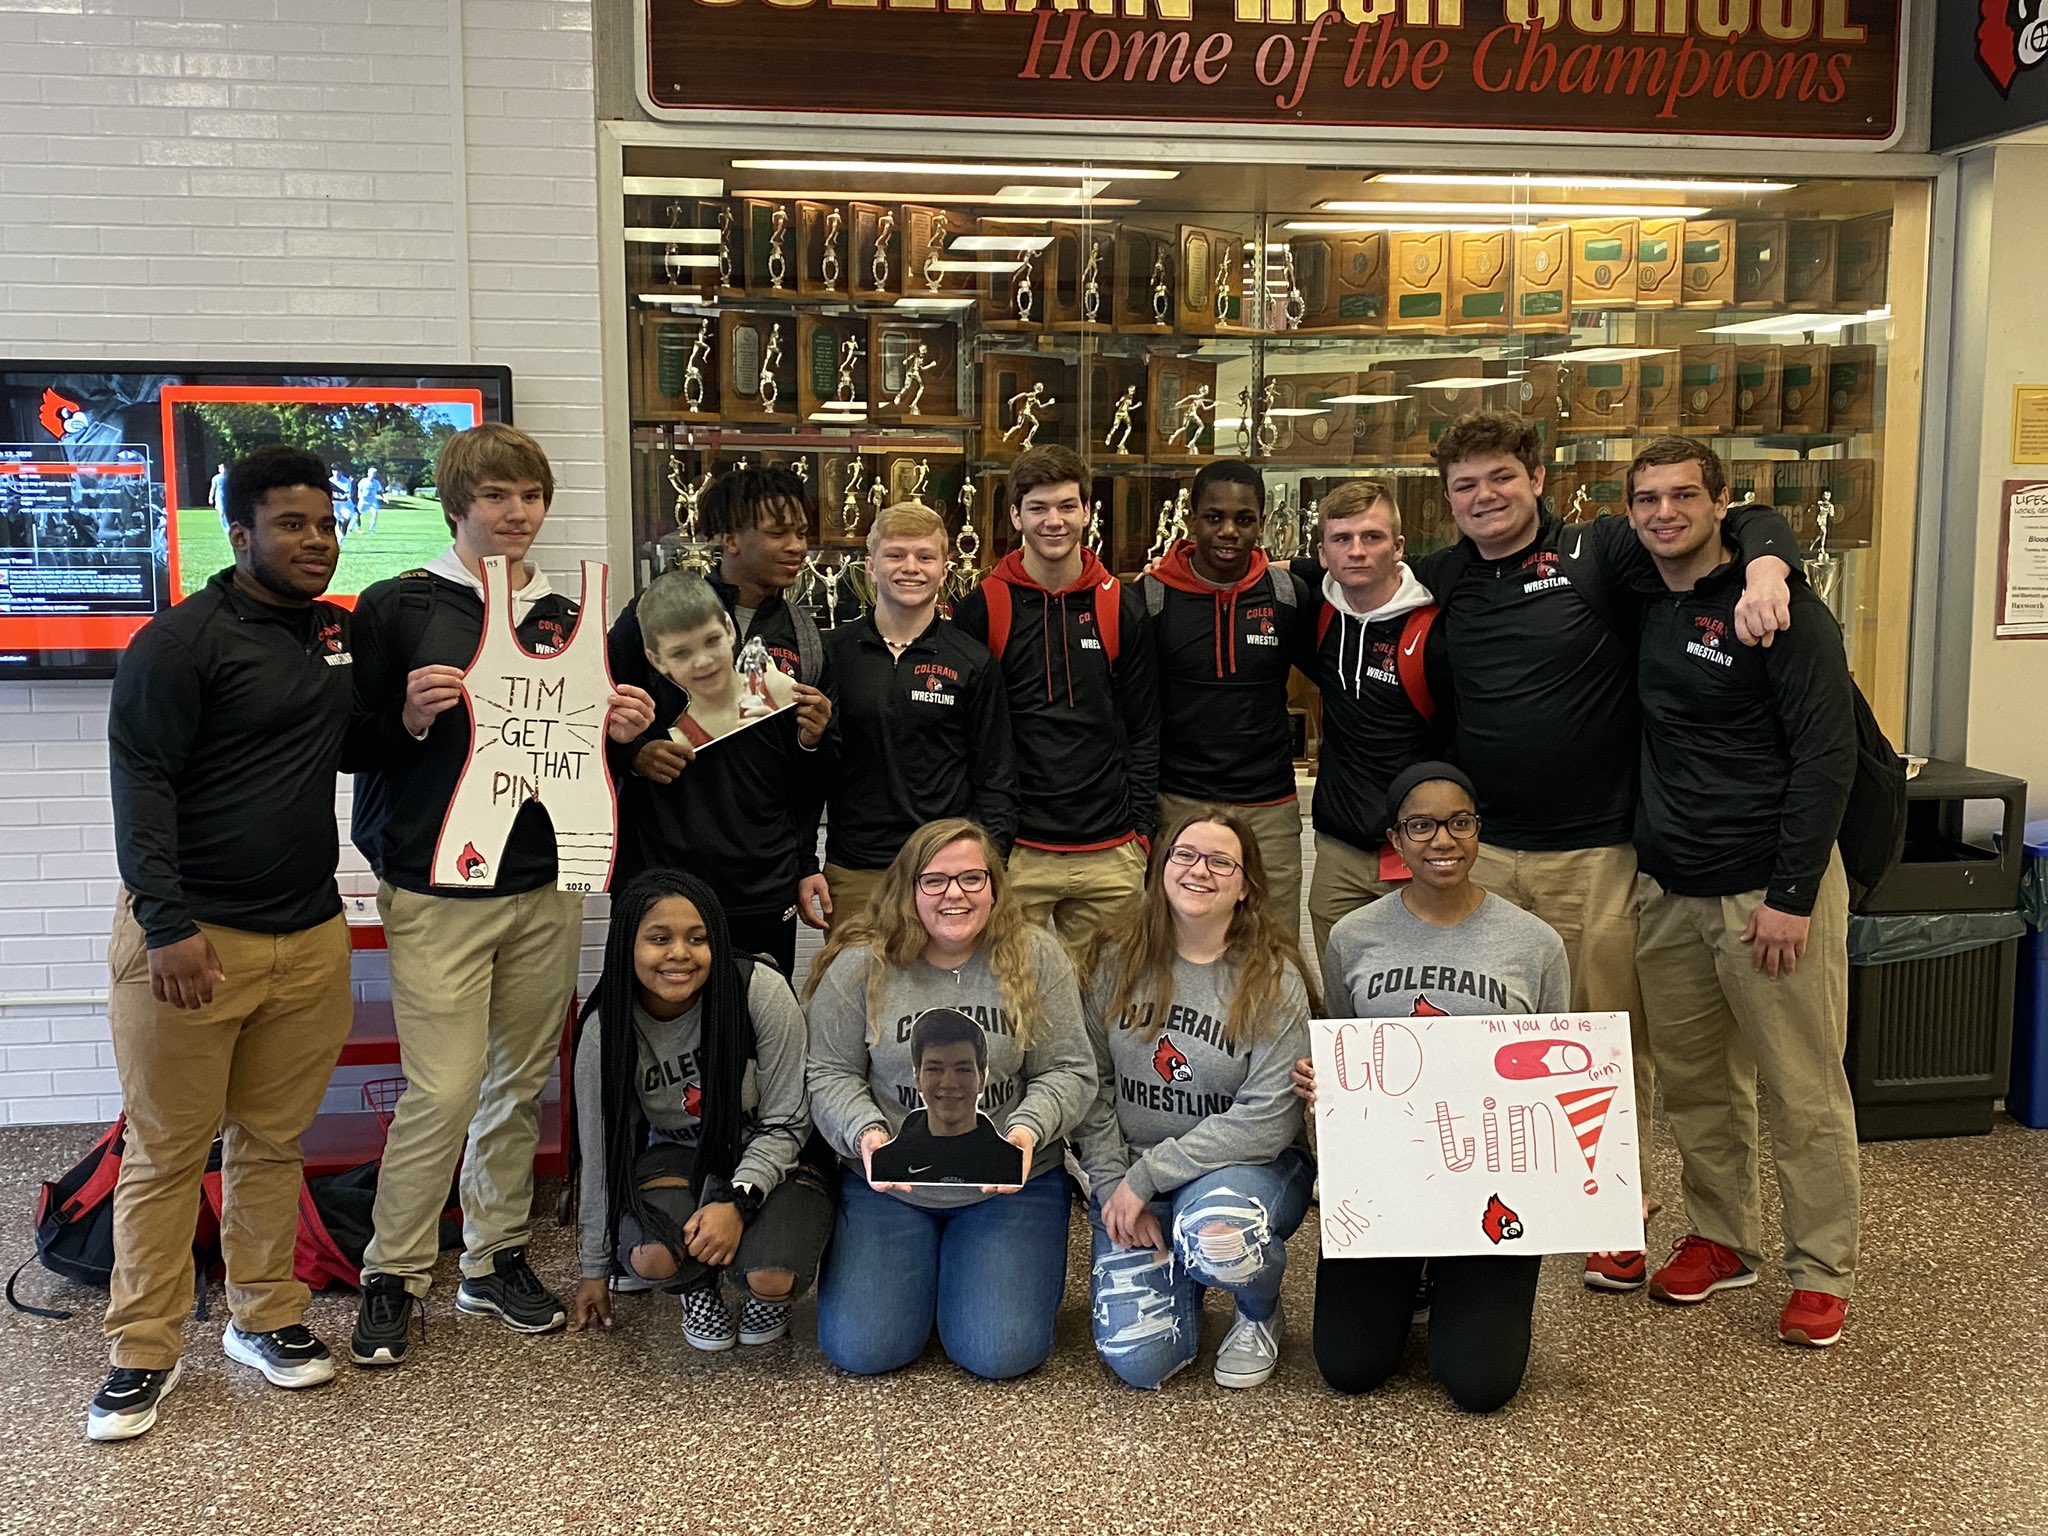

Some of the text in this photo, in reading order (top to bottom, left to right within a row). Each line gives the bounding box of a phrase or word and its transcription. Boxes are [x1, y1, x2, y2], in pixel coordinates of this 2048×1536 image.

[1018, 8, 1233, 85] Home
[1255, 10, 1341, 110] of
[1343, 12, 1449, 90] the
[1472, 17, 1852, 119] Champions
[1523, 576, 1572, 594] WRESTLIN
[914, 664, 958, 680] COLERAIN
[1366, 665, 1399, 685] WRESTL
[501, 676, 565, 713] TIM
[911, 690, 955, 706] WRESTLING
[502, 717, 559, 749] GET
[526, 751, 590, 780] THAT
[493, 771, 540, 808] PIN
[565, 881, 592, 893] 2020
[1367, 965, 1507, 1010] COLERAIN
[1119, 1002, 1236, 1058] COERAIN
[1551, 1016, 1570, 1032] do
[1335, 1023, 1422, 1096] GO
[1426, 1086, 1618, 1195] tim!
[1325, 1199, 1371, 1247] CHS
